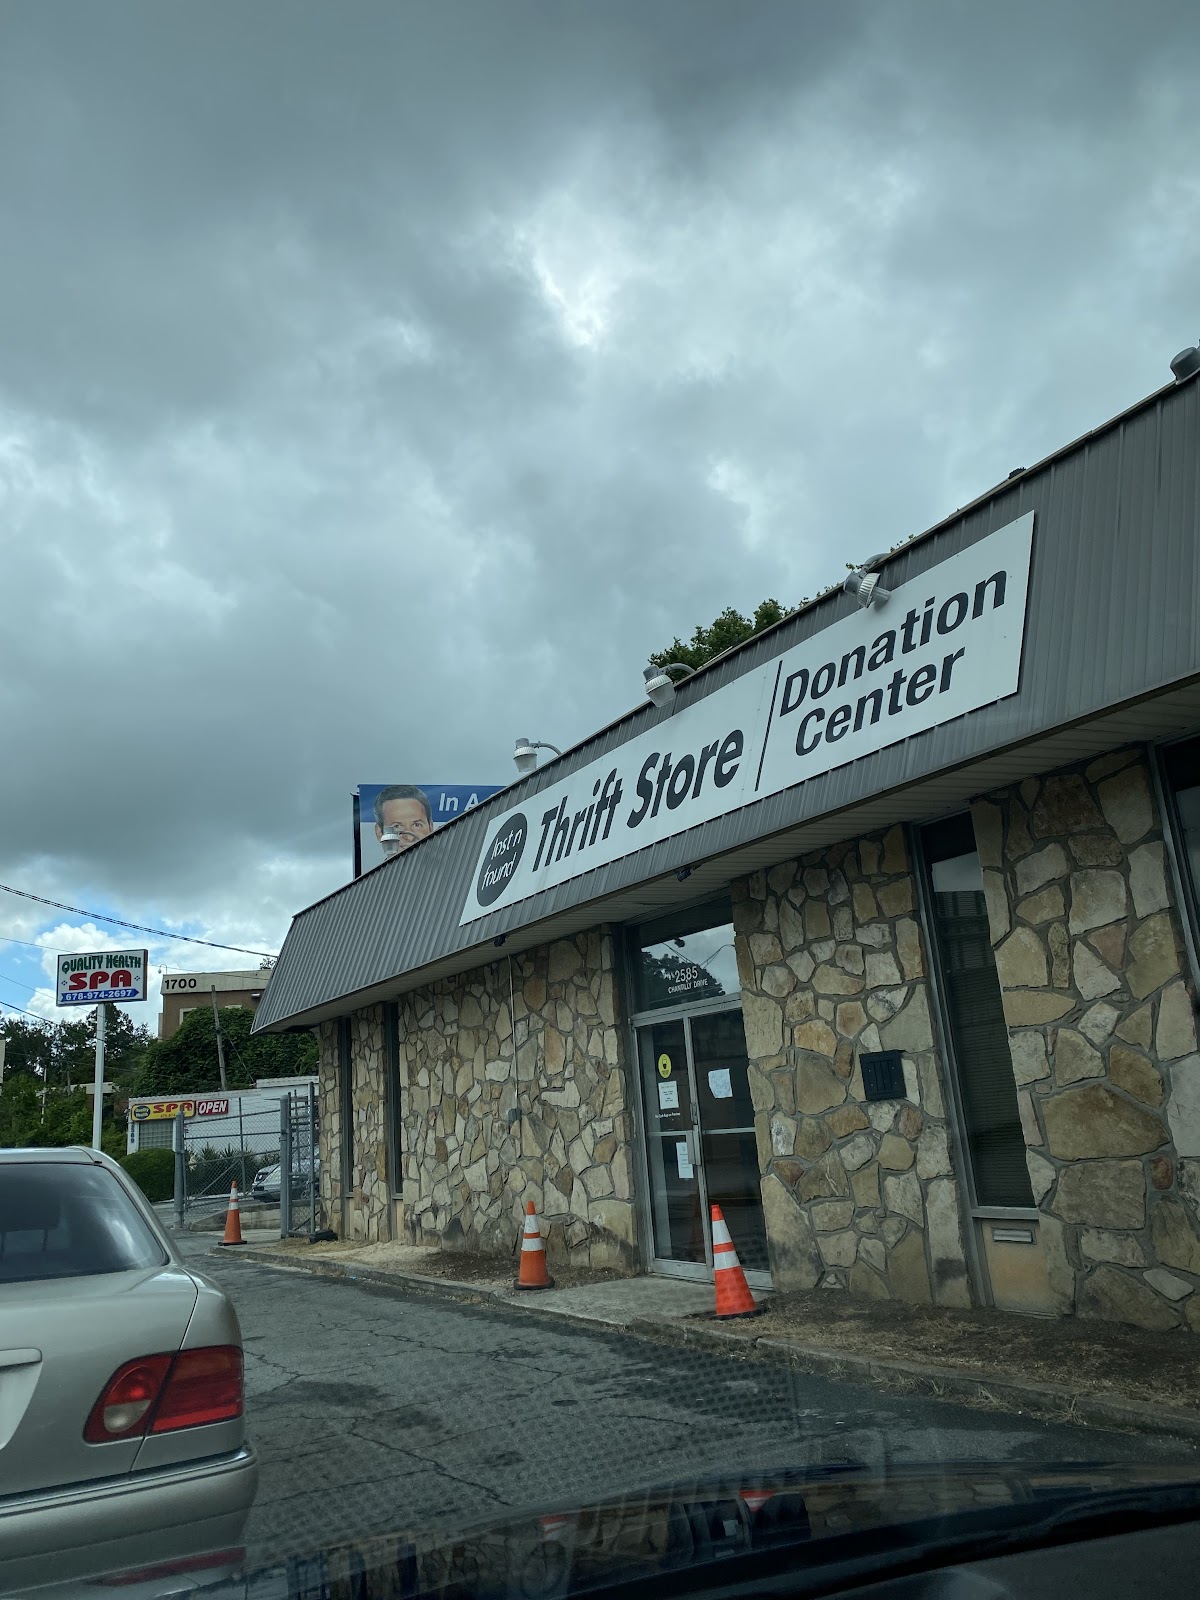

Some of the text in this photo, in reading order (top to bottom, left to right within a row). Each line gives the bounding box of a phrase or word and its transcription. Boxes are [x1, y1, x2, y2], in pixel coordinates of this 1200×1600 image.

[780, 570, 1006, 717] Donation
[796, 646, 965, 756] Center
[438, 792, 459, 812] In
[532, 729, 744, 872] Thrift Store
[491, 829, 514, 860] lost
[481, 852, 518, 891] found
[61, 954, 141, 974] QUALITY HEALTH
[68, 969, 132, 991] SPA
[164, 978, 197, 990] 1700
[674, 965, 698, 984] 2585
[693, 978, 709, 989] DRIVE
[65, 989, 132, 1001] 678-974-2697
[153, 1102, 193, 1114] SPA
[198, 1100, 228, 1114] OPEN
